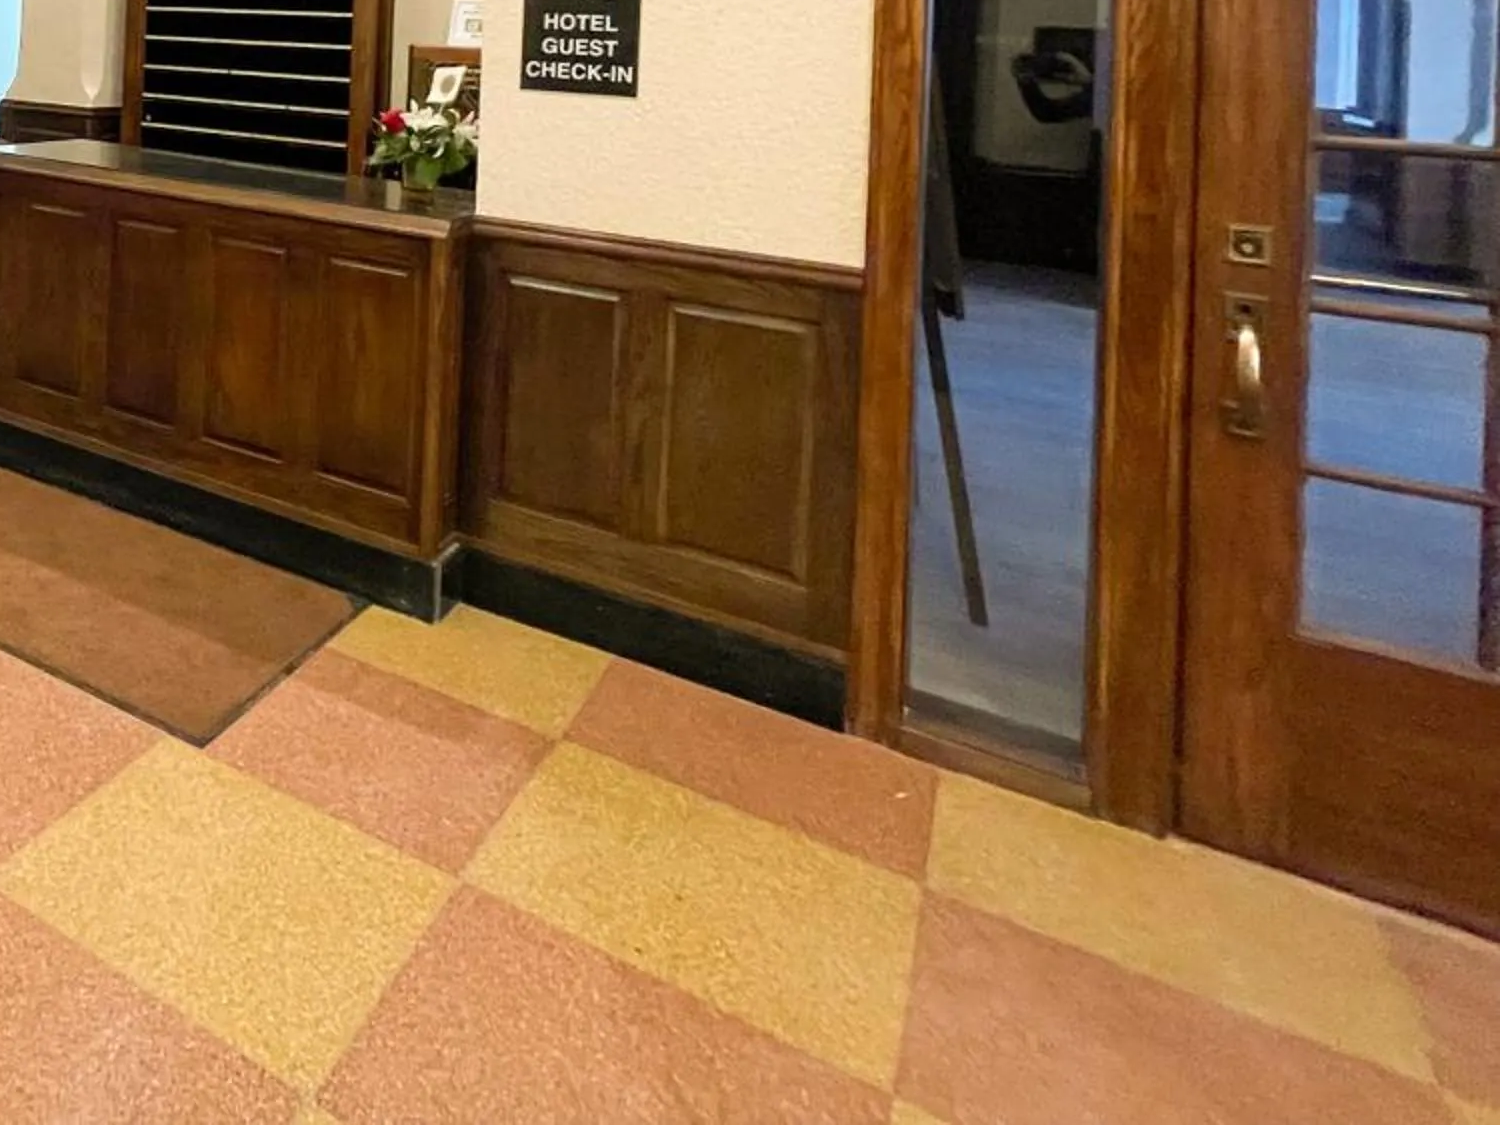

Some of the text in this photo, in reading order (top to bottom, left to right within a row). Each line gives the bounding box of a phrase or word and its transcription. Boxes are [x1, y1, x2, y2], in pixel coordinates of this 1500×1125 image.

[543, 12, 619, 33] HOTEL
[541, 37, 619, 58] GUEST
[525, 60, 634, 84] CHECK-IN
